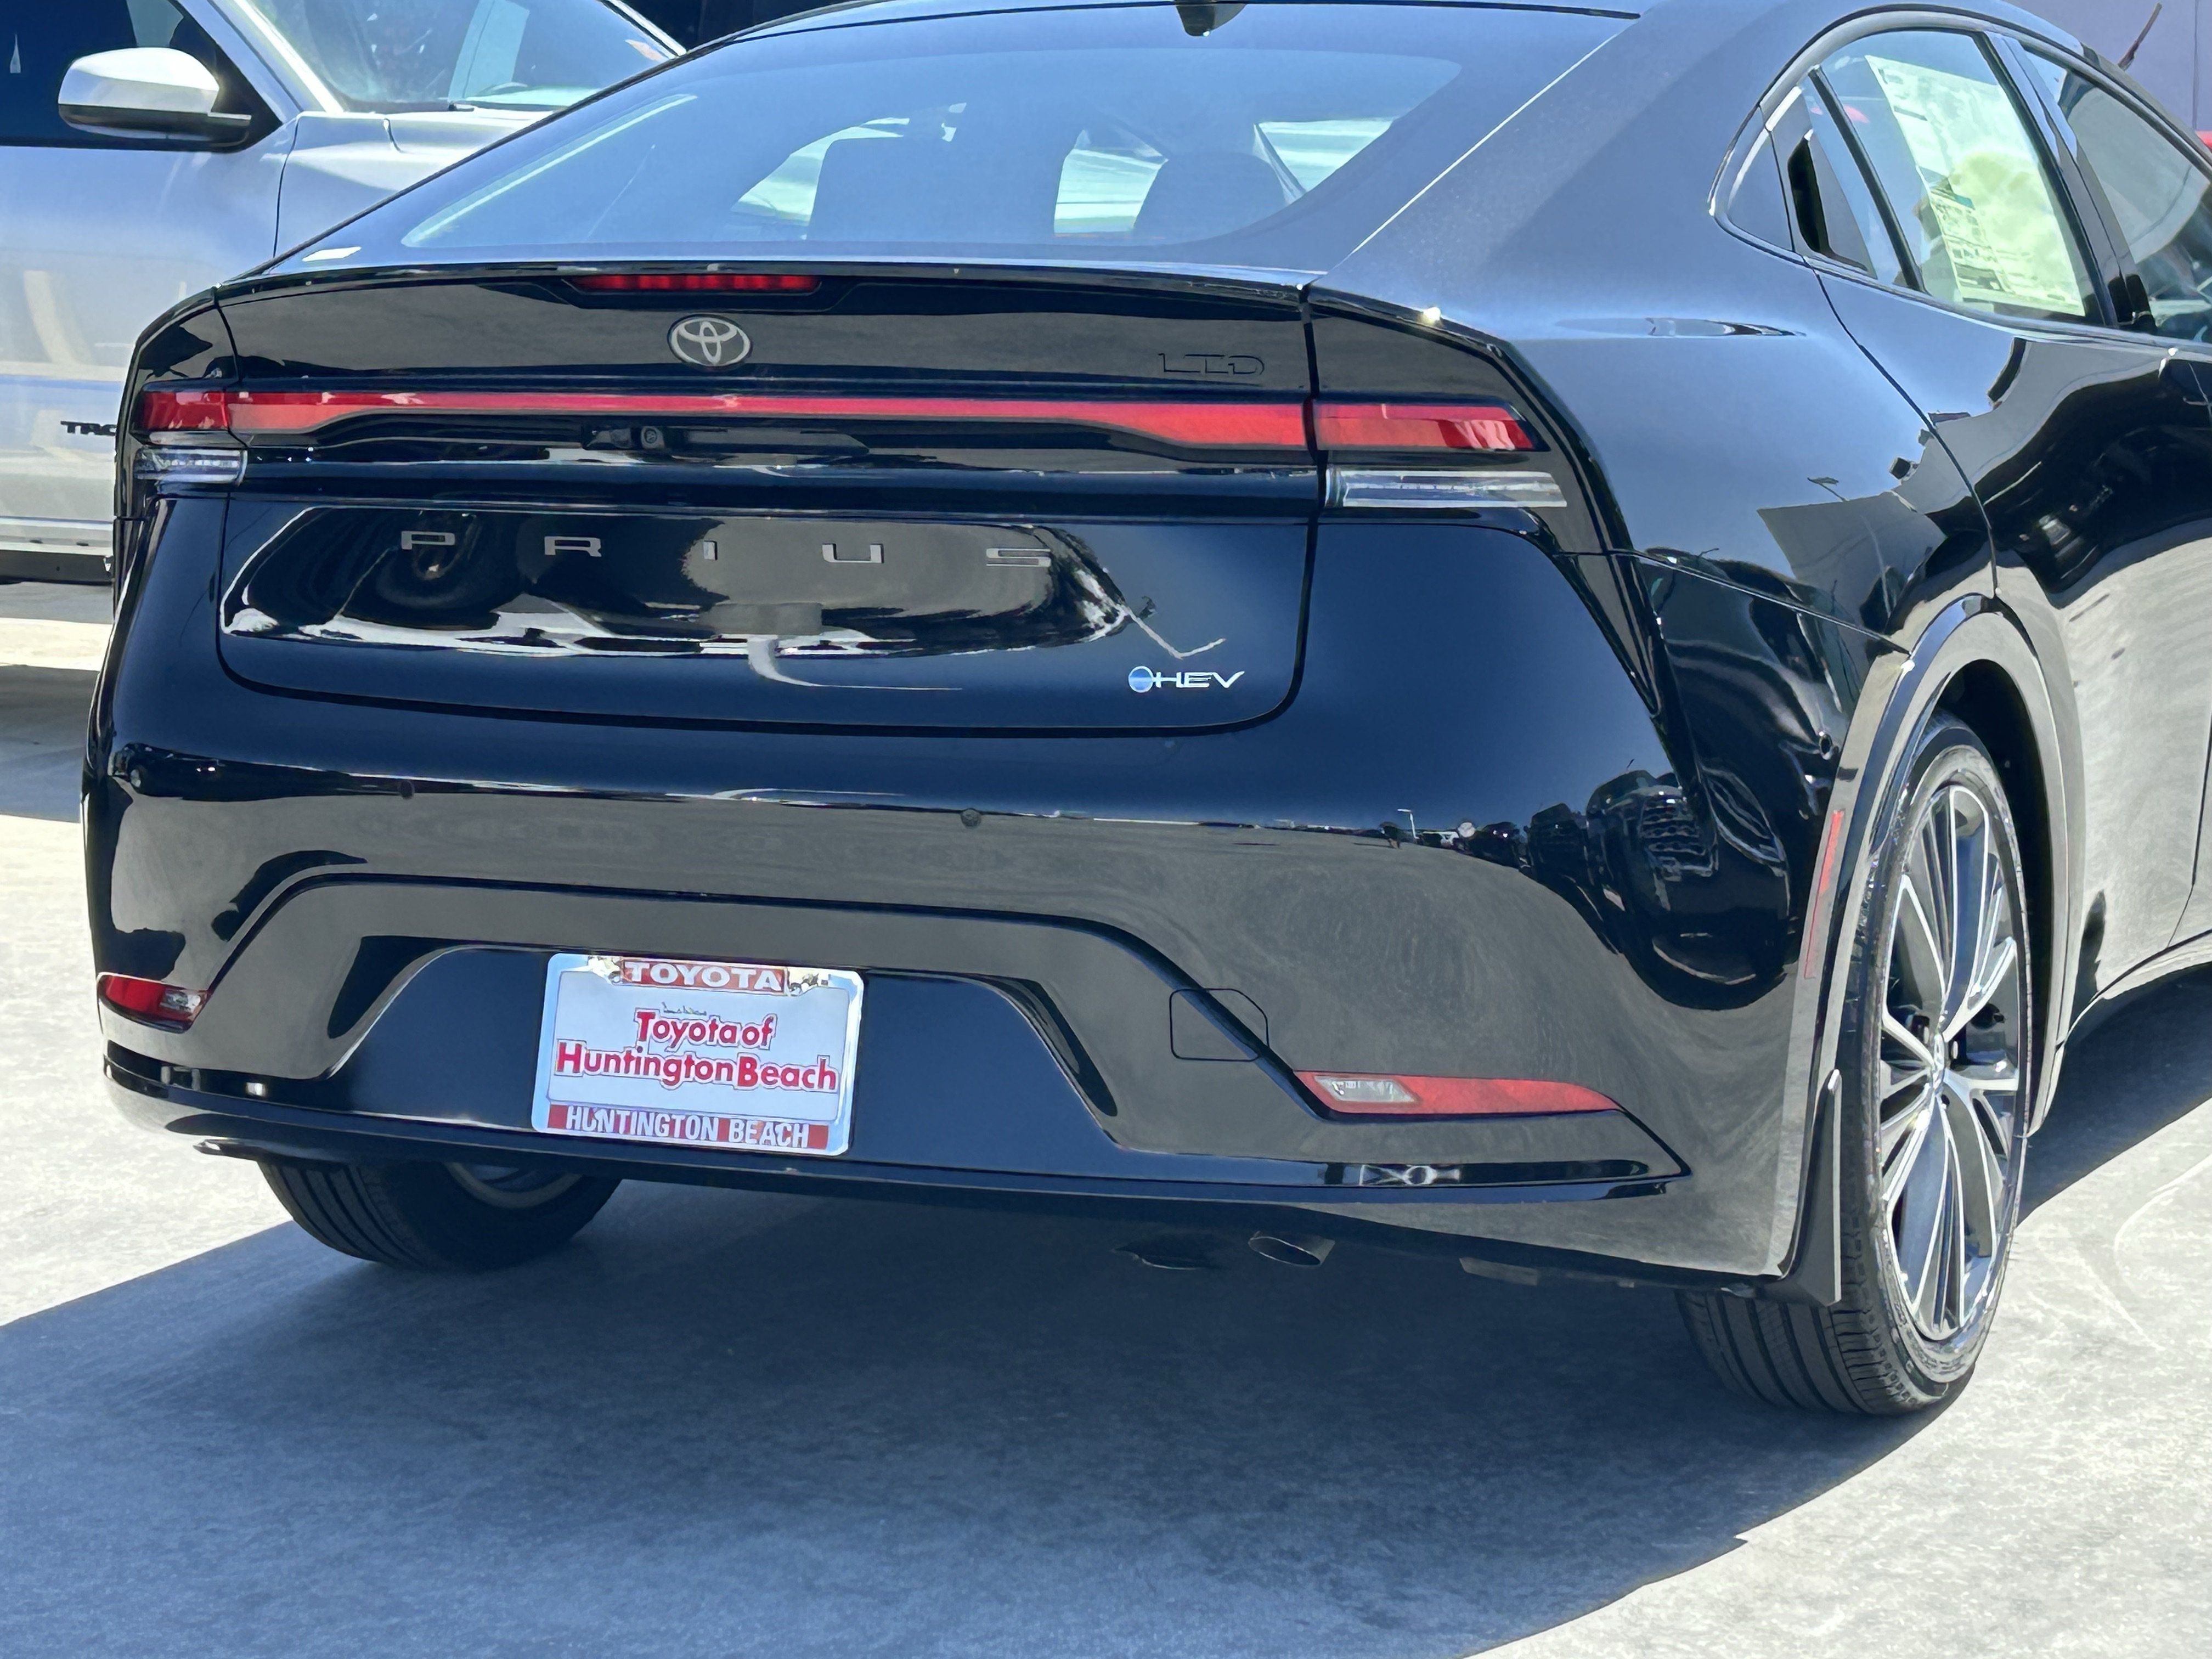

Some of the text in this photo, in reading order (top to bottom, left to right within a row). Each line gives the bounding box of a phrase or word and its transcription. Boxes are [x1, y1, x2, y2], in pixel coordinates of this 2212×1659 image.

[1158, 353, 1265, 375] LTD
[400, 530, 1052, 567] PRIUS
[624, 961, 782, 991] TOYOTA
[635, 1011, 775, 1049] Toyota of
[555, 1041, 837, 1090] Huntington Beach
[566, 1105, 809, 1148] HUNTINGTON BEACH
